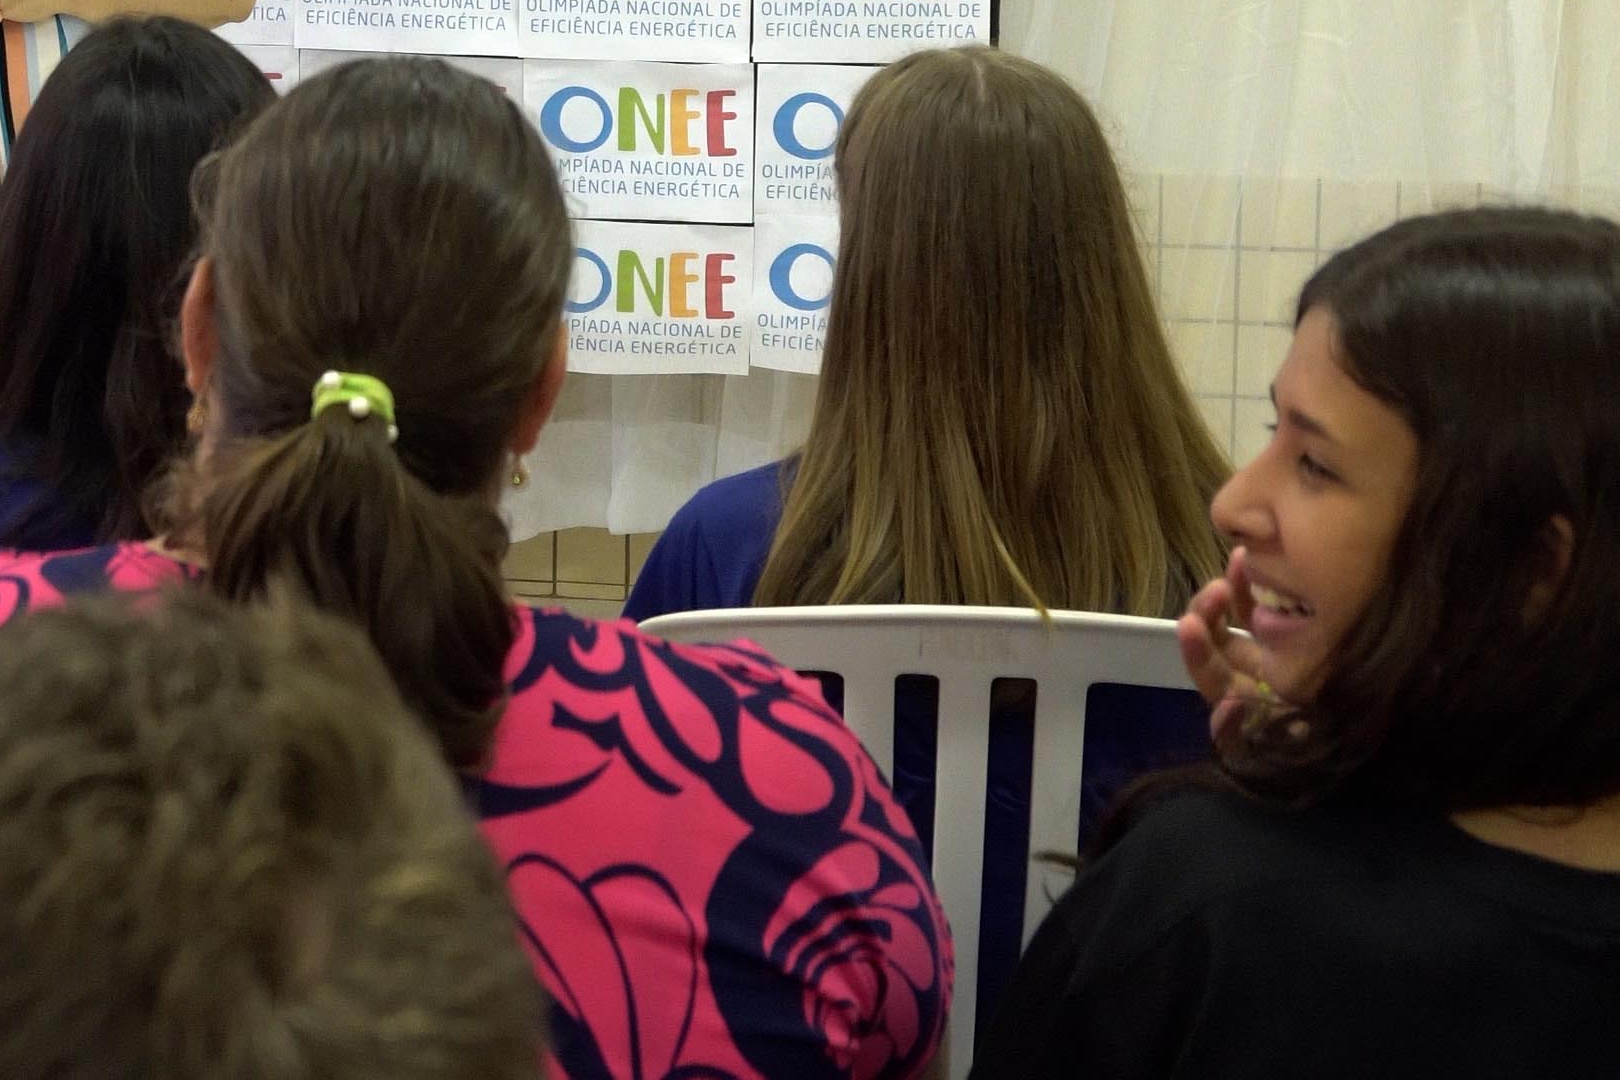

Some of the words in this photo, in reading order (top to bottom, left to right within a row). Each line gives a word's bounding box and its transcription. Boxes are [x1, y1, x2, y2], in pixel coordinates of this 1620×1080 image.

[627, 0, 714, 17] NACIONAL
[720, 3, 741, 17] DE
[761, 0, 857, 18] OLIMPÍADA
[864, 2, 953, 18] NACIONAL
[959, 3, 980, 18] DE
[307, 8, 396, 27] EFICIÊNCIA
[401, 12, 506, 31] ENERGÉTICA
[531, 16, 623, 35] EFICIÊNCIA
[630, 18, 736, 39] ENERGÉTICA
[766, 19, 861, 39] EFICIÊNCIA
[867, 20, 977, 40] ENERGÉTICA
[541, 87, 737, 157] ONEE
[630, 160, 717, 177] NACIONAL
[723, 163, 745, 178] DE
[633, 177, 740, 199] ENERGÉTICA
[627, 320, 715, 339] NACIONAL
[721, 325, 742, 339] DE
[631, 337, 736, 355] ENERGÉTICA
